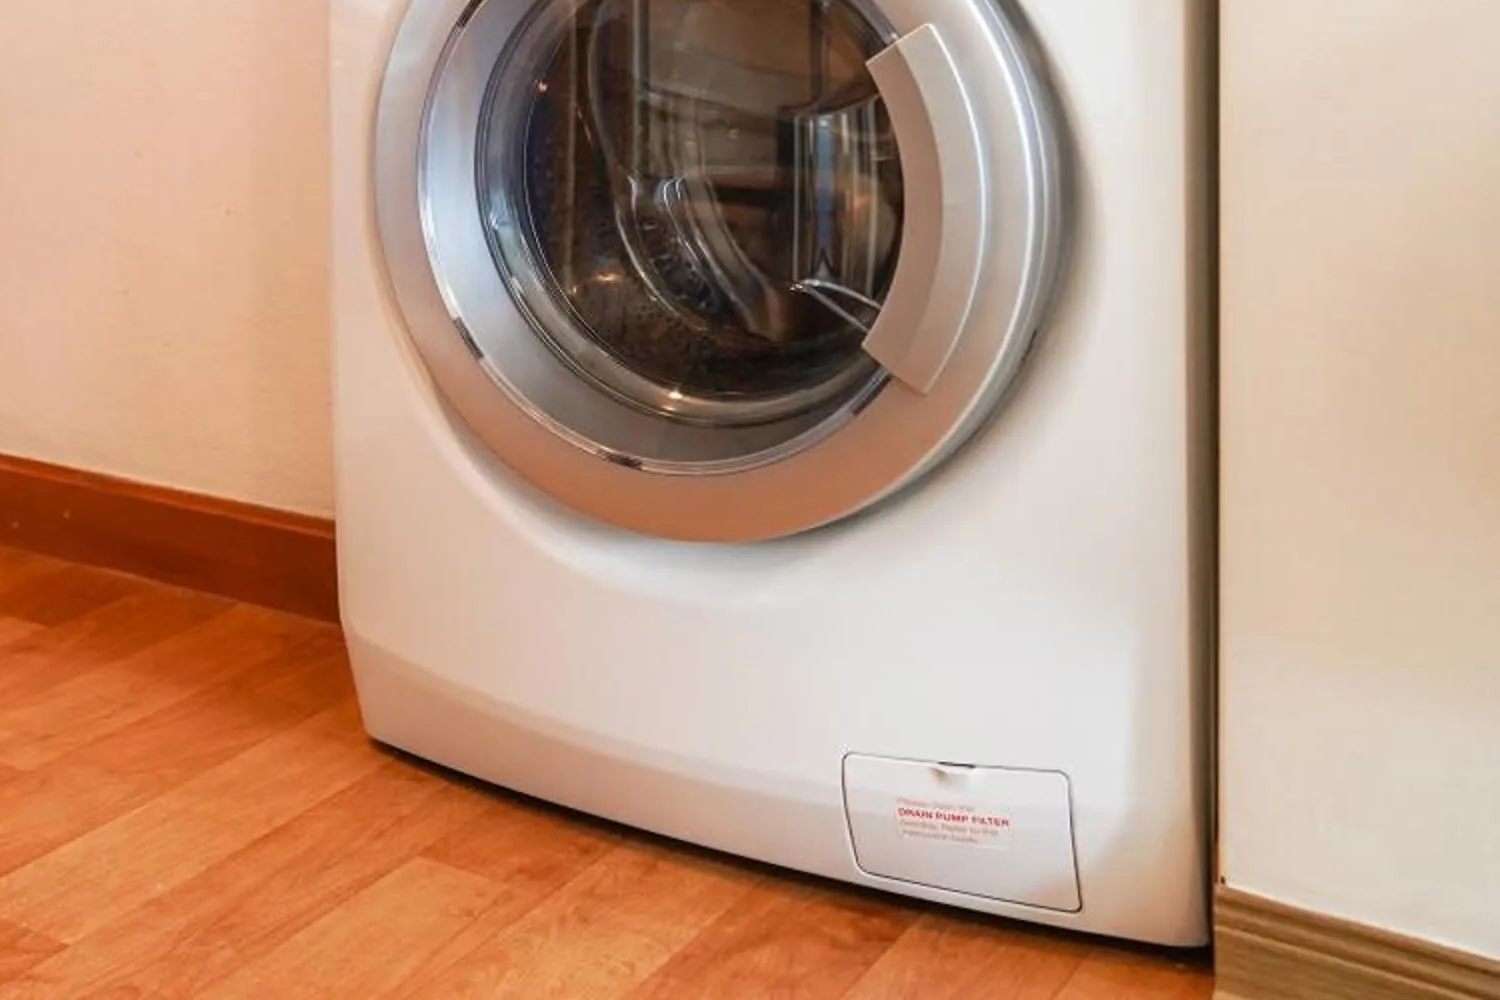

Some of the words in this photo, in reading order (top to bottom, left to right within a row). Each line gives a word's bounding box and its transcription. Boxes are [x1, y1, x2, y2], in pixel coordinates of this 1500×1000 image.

[898, 807, 933, 819] DRAIN
[935, 811, 968, 822] PUMP
[972, 815, 1009, 826] FILTER
